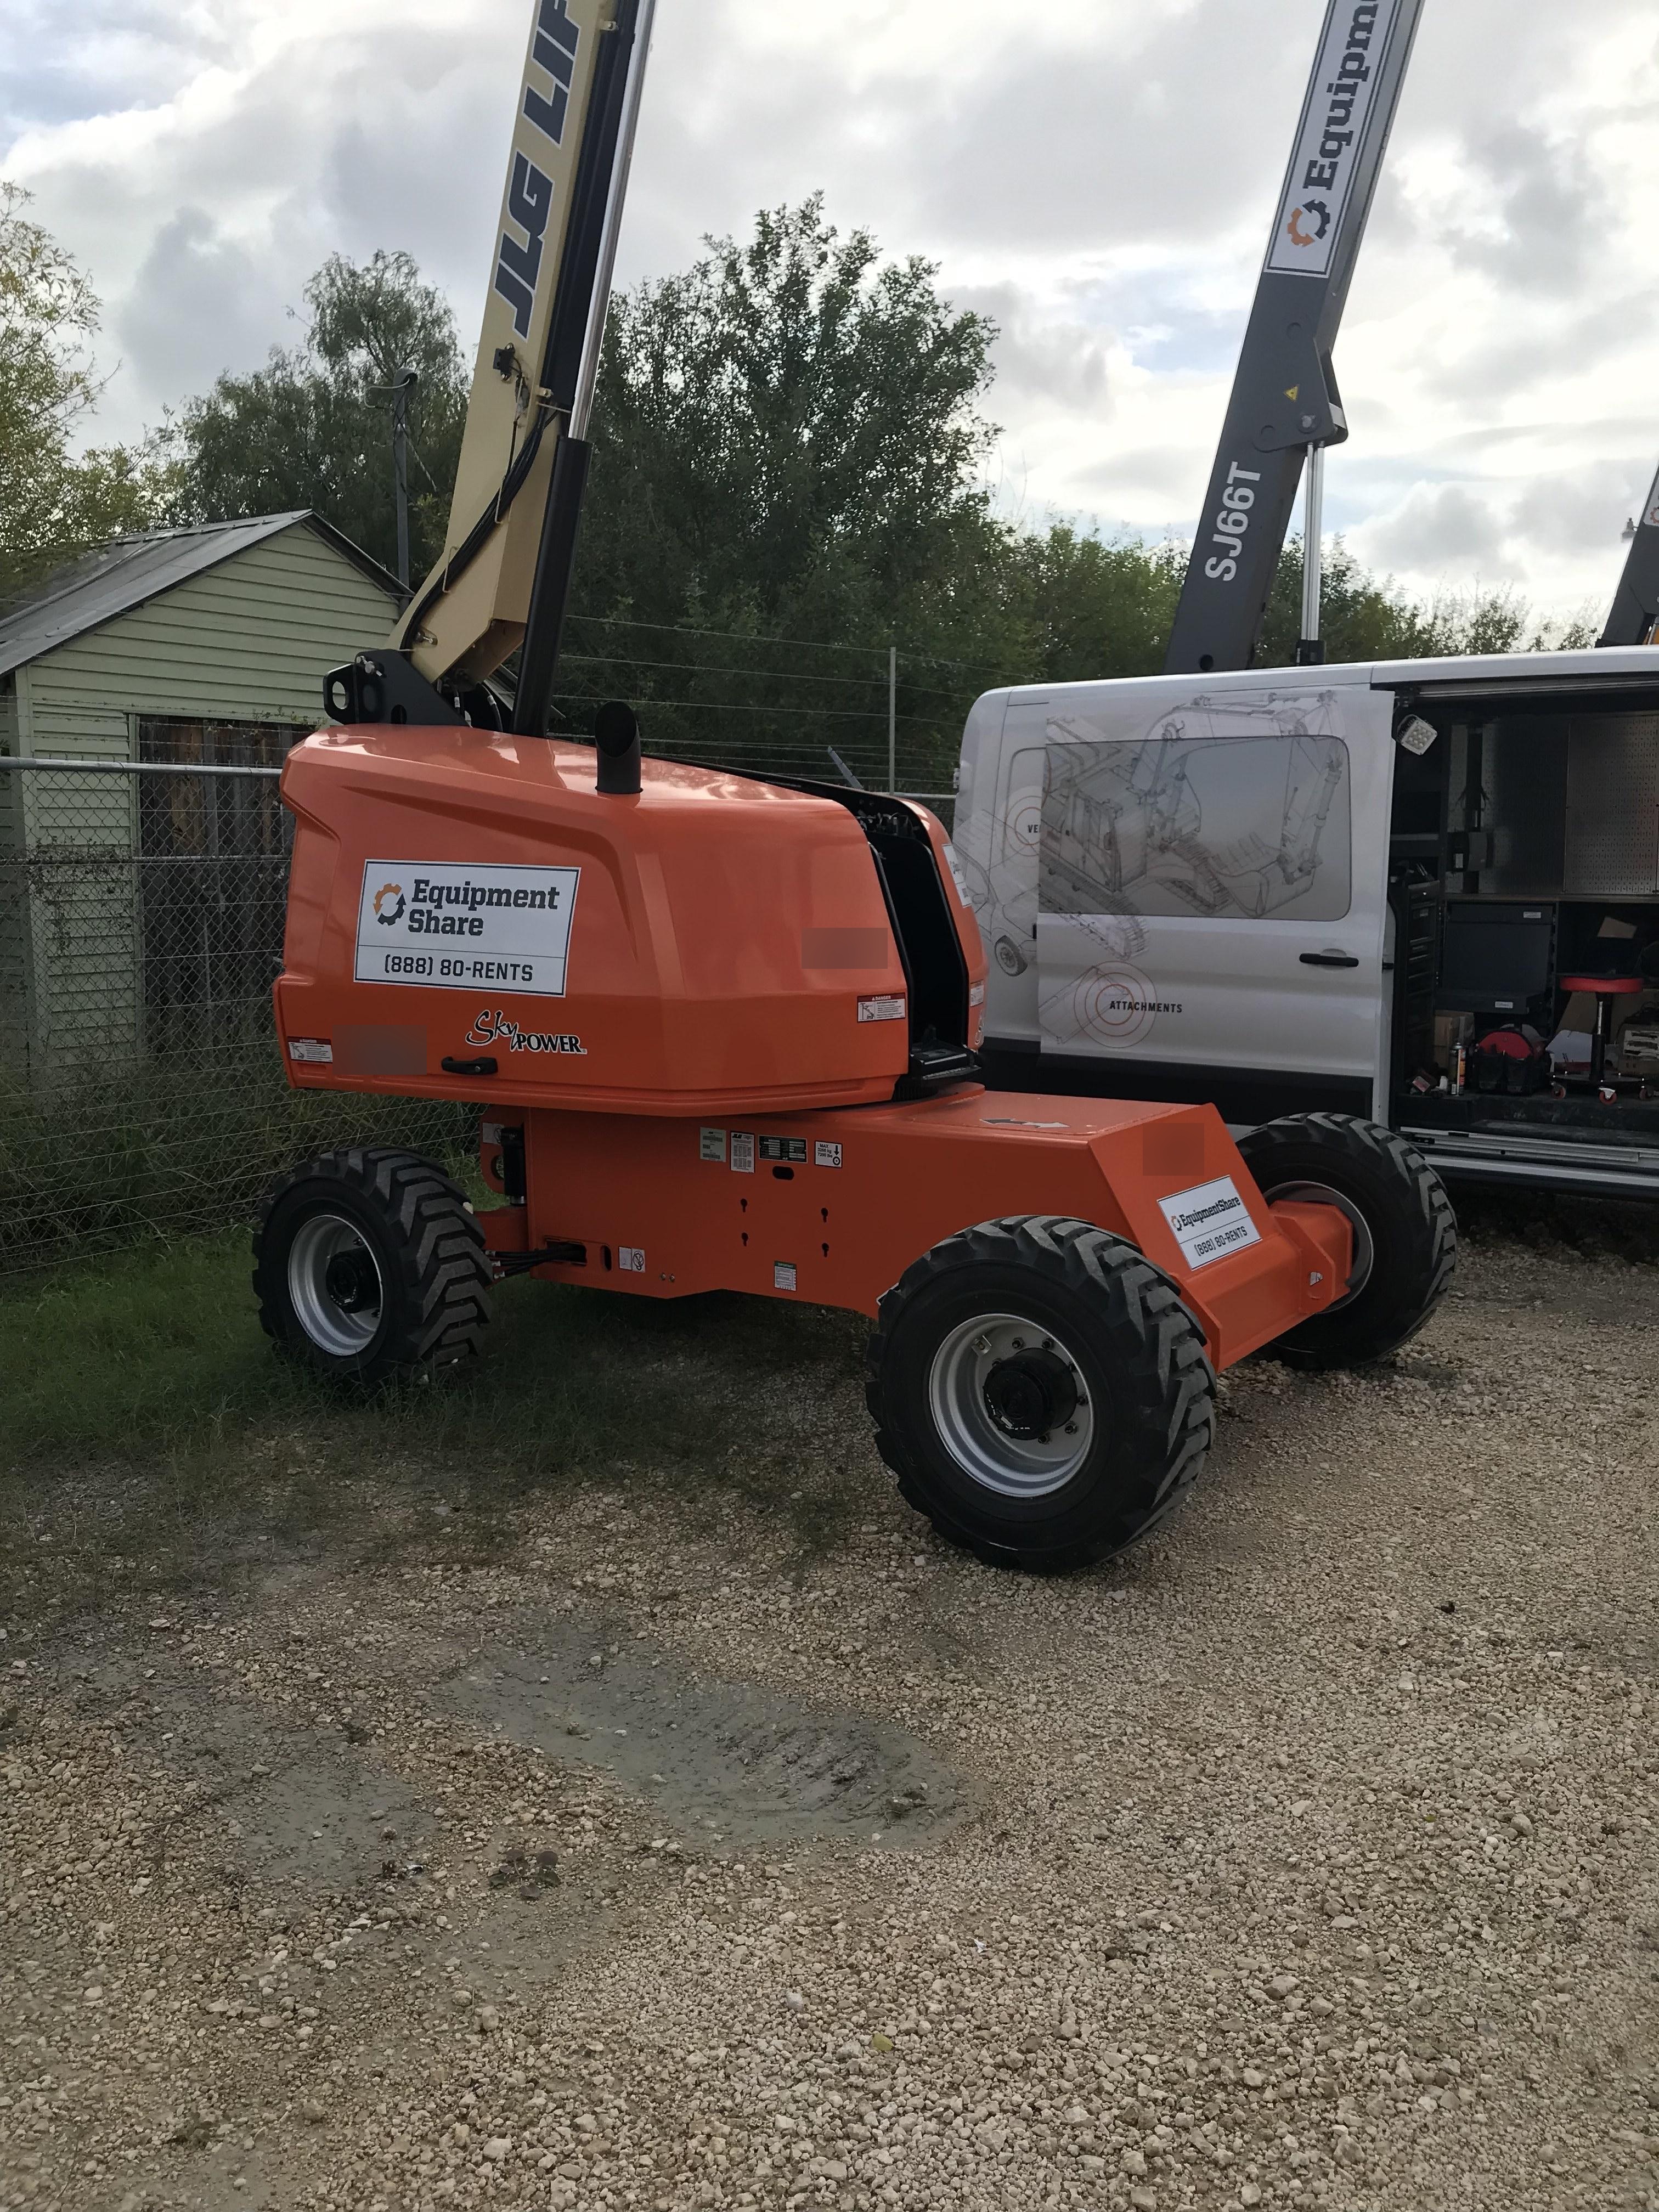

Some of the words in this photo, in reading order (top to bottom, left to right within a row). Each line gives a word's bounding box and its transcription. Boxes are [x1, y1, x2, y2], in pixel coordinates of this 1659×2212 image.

[1302, 0, 1379, 190] Equipm
[494, 149, 555, 341] JLG
[1205, 461, 1261, 582] SJ66T
[1028, 824, 1041, 833] VE
[411, 879, 560, 911] Equipment
[408, 909, 484, 936] Share
[385, 954, 433, 976] (888)
[440, 959, 533, 981] 80-RENTS
[1109, 1001, 1183, 1013] ATTACHMENTS
[1180, 1197, 1240, 1227] EquipmentShare
[1194, 1238, 1216, 1256] (888)
[1215, 1226, 1248, 1247] 80-RENTS
